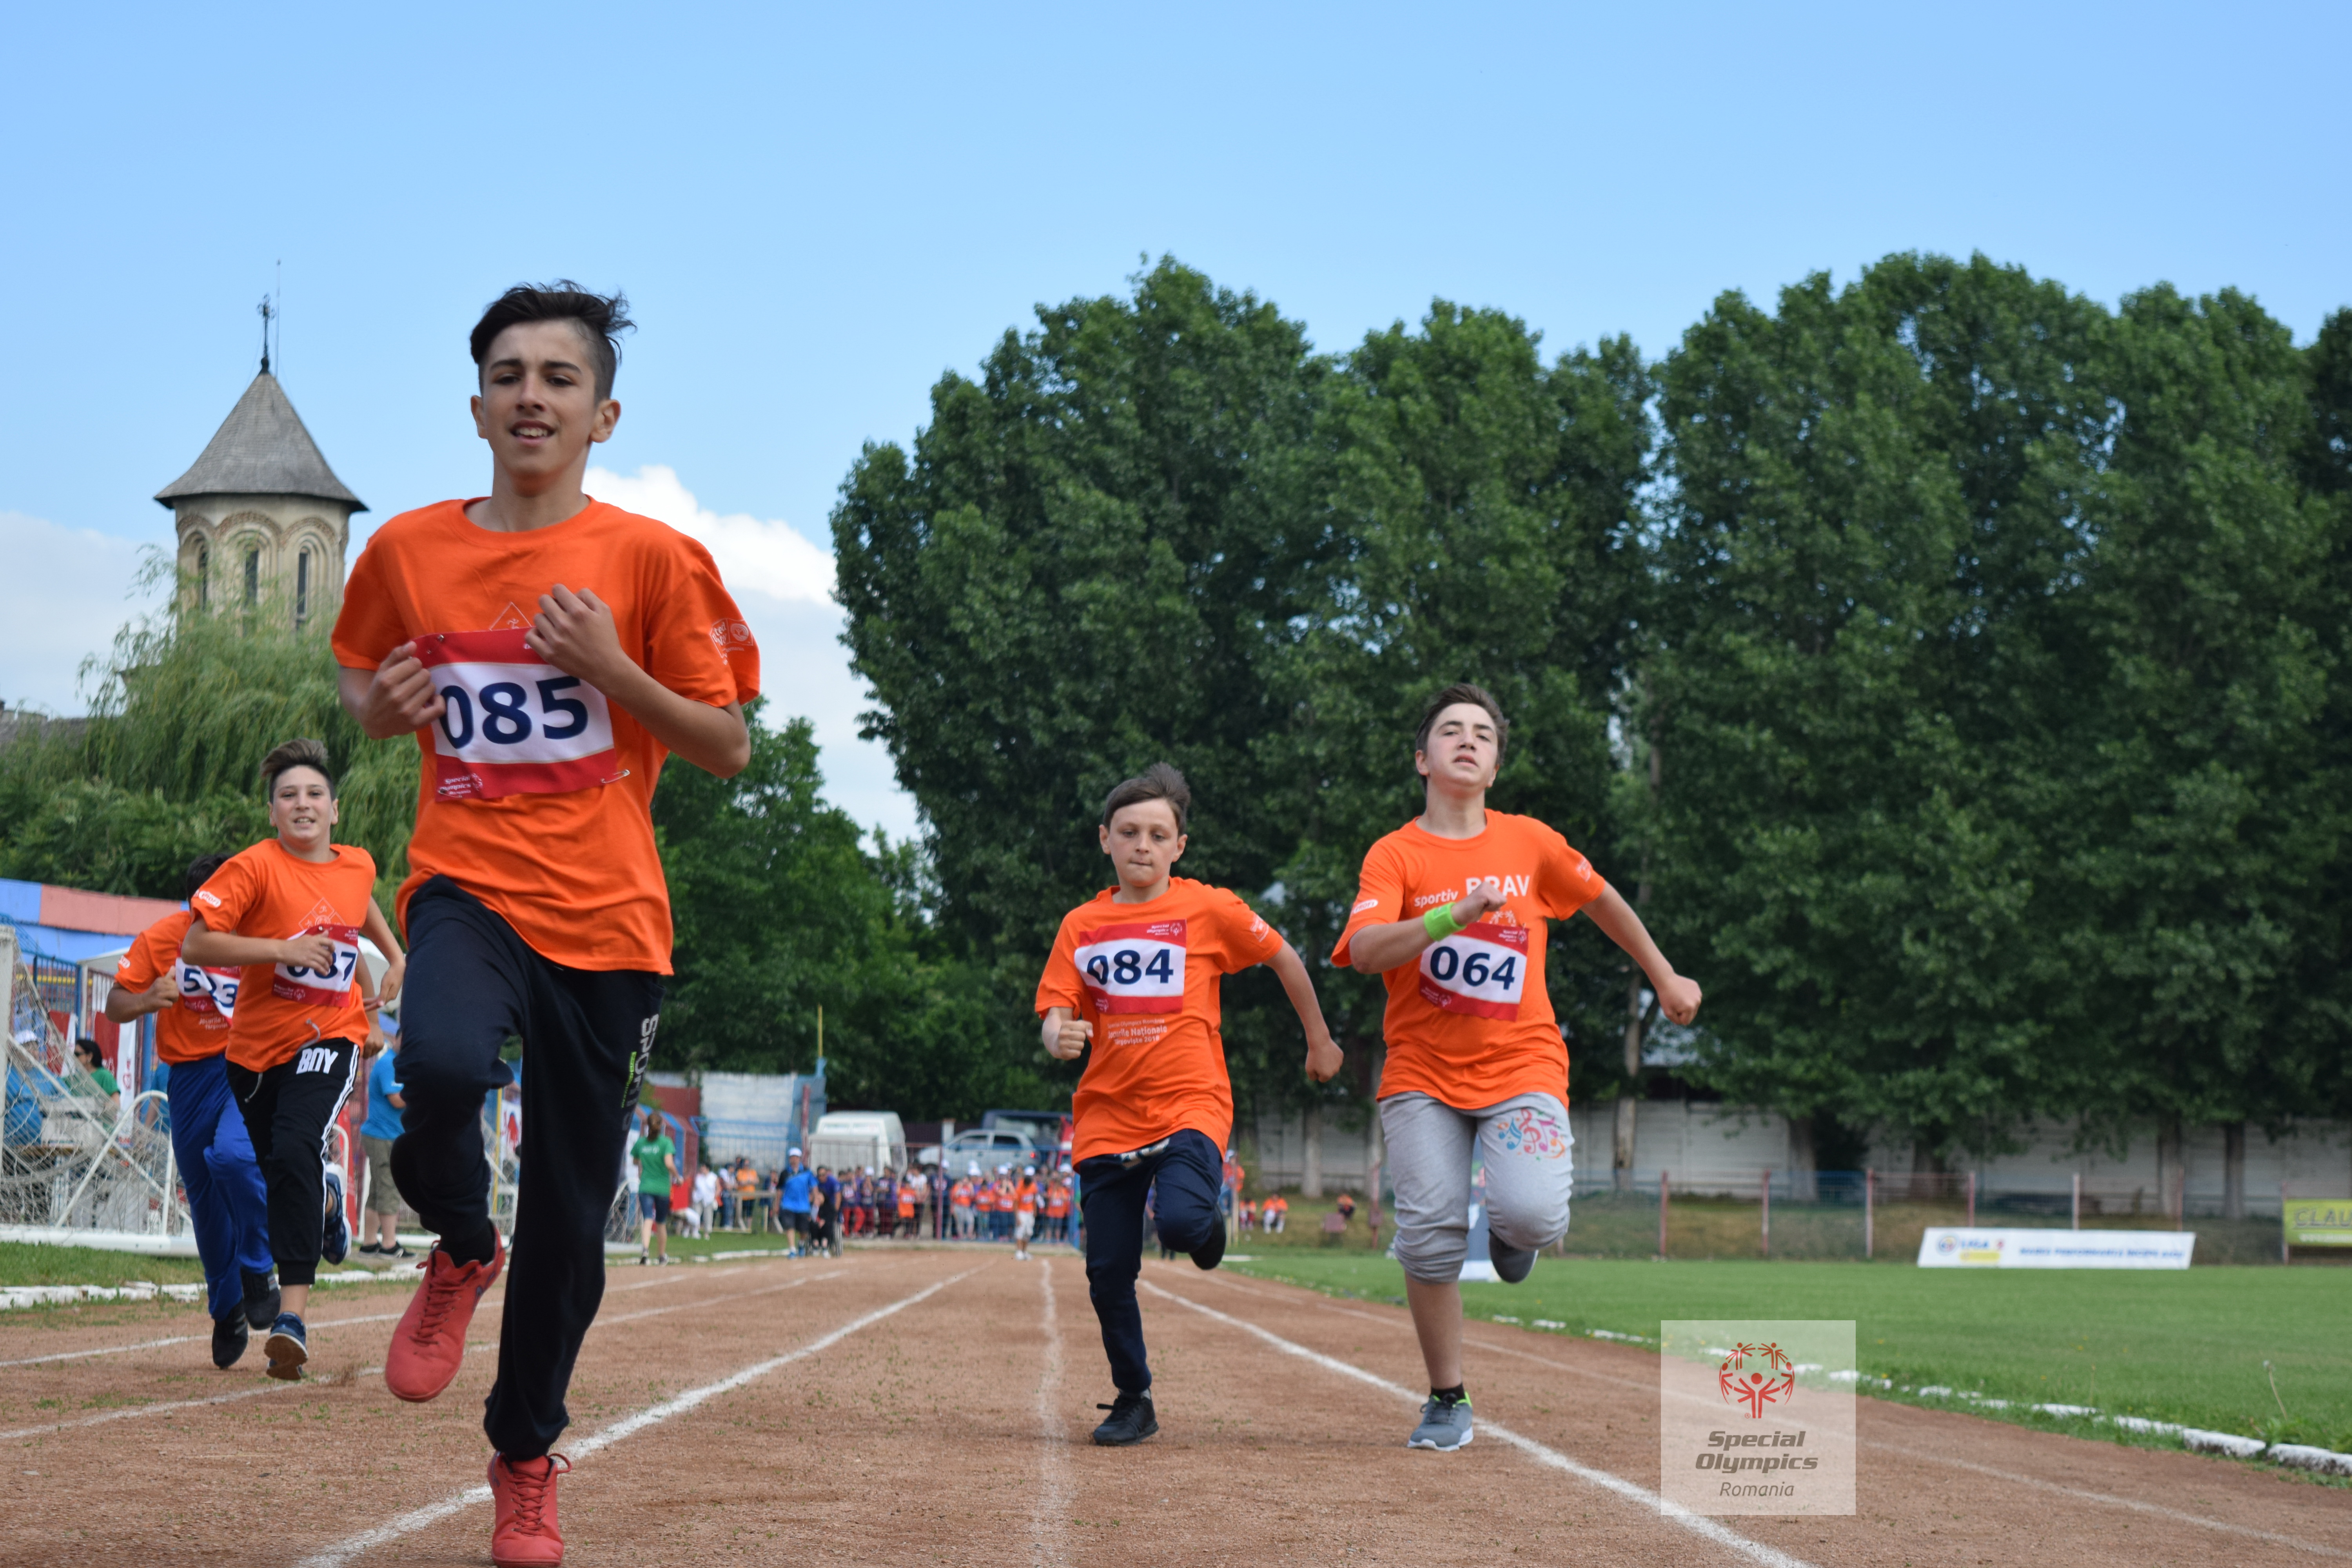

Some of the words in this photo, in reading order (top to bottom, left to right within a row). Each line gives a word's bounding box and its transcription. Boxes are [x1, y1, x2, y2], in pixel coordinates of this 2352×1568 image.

[439, 676, 588, 750] 085
[1414, 889, 1458, 908] sportiv
[1087, 949, 1174, 985] 084
[1430, 946, 1516, 991] 064
[296, 1047, 339, 1074] BOY
